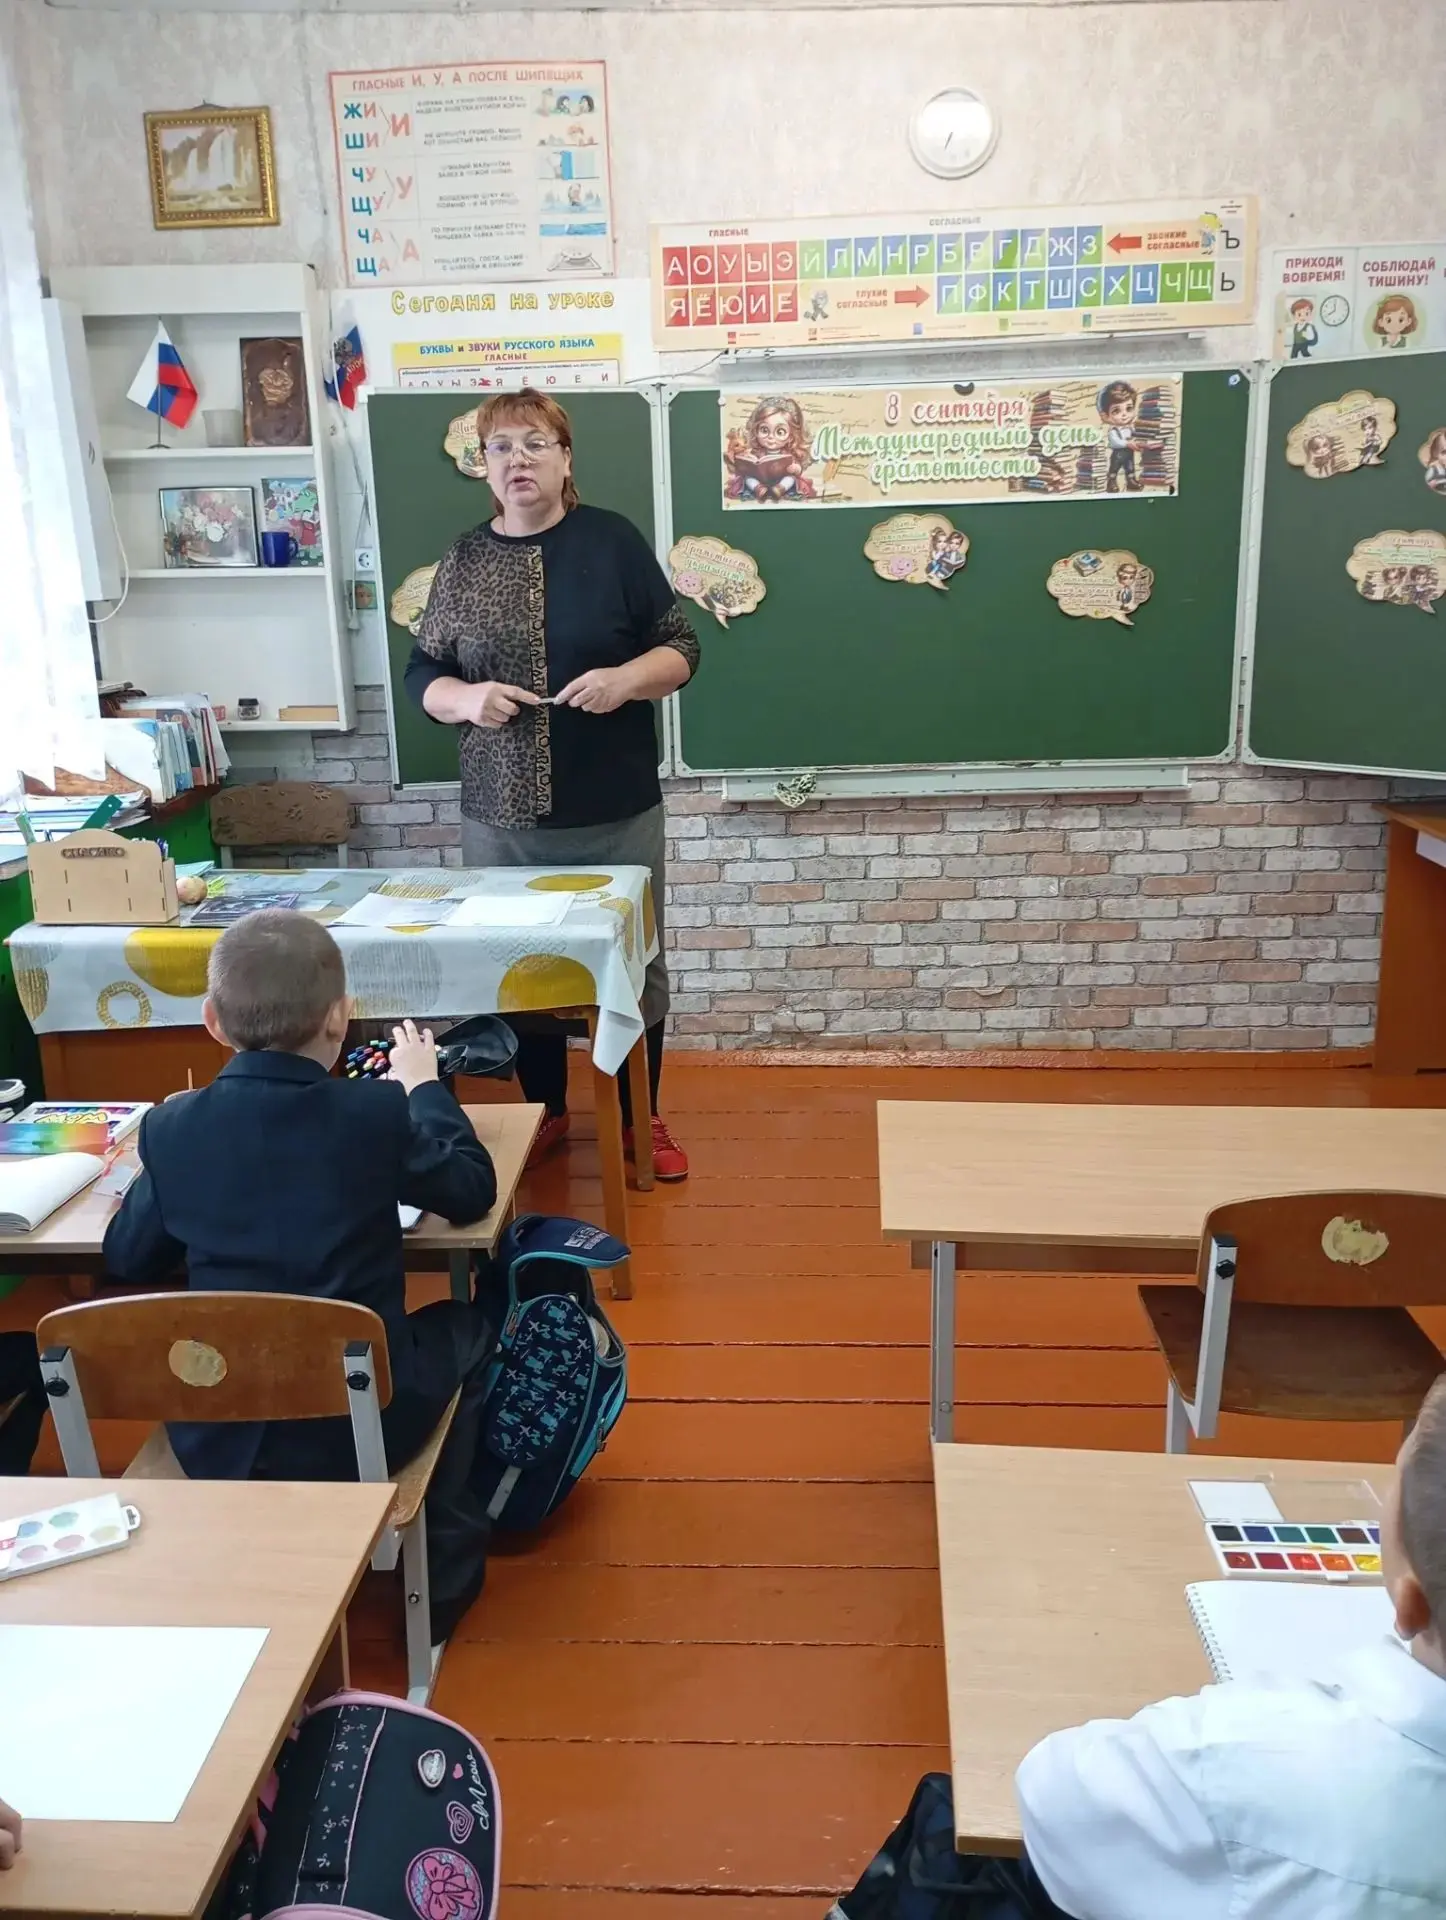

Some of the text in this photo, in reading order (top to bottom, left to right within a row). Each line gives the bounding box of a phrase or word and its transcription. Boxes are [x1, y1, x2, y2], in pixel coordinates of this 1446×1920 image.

[352, 77, 405, 91] ГЛАСНЫЕ
[452, 72, 462, 84] А
[468, 70, 509, 83] ПОСЛЕ
[343, 101, 376, 119] ЖИ
[391, 112, 411, 137] И
[345, 132, 379, 150] ШИ
[352, 166, 376, 183] ЧУ
[396, 175, 413, 200] У
[351, 195, 384, 216] ЩУ
[357, 227, 384, 244] ЧА
[1221, 230, 1240, 249] Ъ
[402, 239, 420, 262] А
[668, 256, 684, 276] А
[693, 255, 712, 275] О
[722, 253, 737, 274] У
[747, 252, 767, 272] Ы
[776, 251, 793, 272] Э
[804, 248, 820, 272] Й
[832, 248, 848, 269] Л
[857, 247, 877, 267] М
[887, 245, 903, 265] Н
[914, 244, 929, 264] Р
[942, 242, 957, 263] Б
[999, 239, 1012, 260] Г
[1024, 236, 1042, 265] Д
[1049, 236, 1074, 257] Ж
[1082, 234, 1097, 256] З
[356, 256, 391, 277] ЩА
[1285, 256, 1343, 269] ПРИХОДИ
[1362, 257, 1436, 273] СОБЛЮДАЙ
[942, 269, 1211, 305] П Ф К Т Ш С Х Ц Ч Щ
[1220, 271, 1235, 292] Ь
[1282, 270, 1345, 284] ВОВРЕМЯ!
[1368, 275, 1429, 288] ТИШИНУ!
[391, 290, 615, 316] Сегодня на уроке
[670, 293, 793, 318] Я Ё Ю И Е
[420, 338, 595, 355] БУКВЫ и ЗВУКИ РУССКОГО ЯЗЫКА
[485, 353, 527, 362] ГЛАСНЫЕ
[496, 378, 503, 387] Я
[546, 375, 556, 385] Ю
[601, 372, 609, 382] И
[887, 393, 1026, 427] 8 сентября
[815, 424, 1100, 459] Международный день
[873, 455, 1038, 488] грамотности
